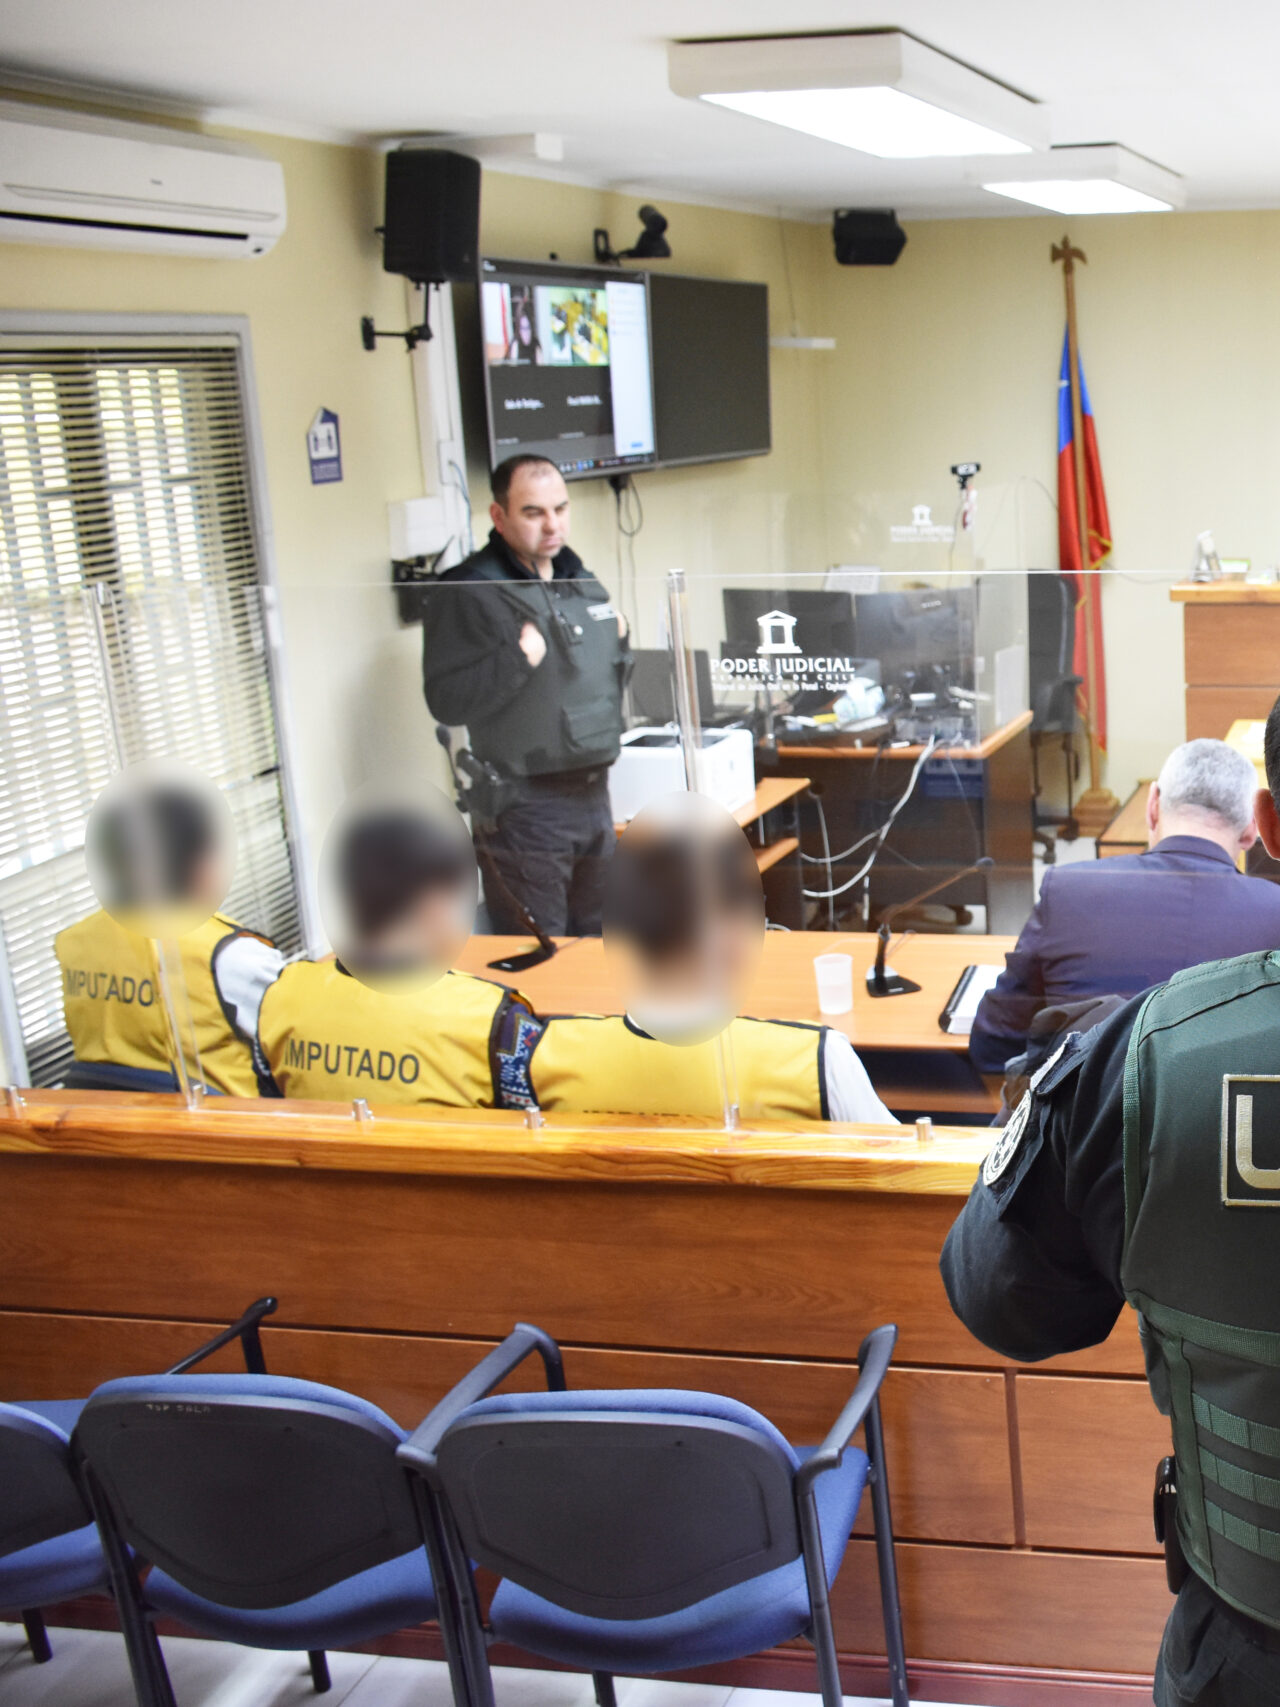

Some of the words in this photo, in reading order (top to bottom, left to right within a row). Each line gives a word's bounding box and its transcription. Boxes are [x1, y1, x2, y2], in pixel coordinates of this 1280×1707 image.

[710, 658, 770, 674] PODER
[775, 657, 856, 676] JUDICIAL
[66, 968, 154, 1007] MPUTADO
[285, 1038, 420, 1084] IMPUTADO
